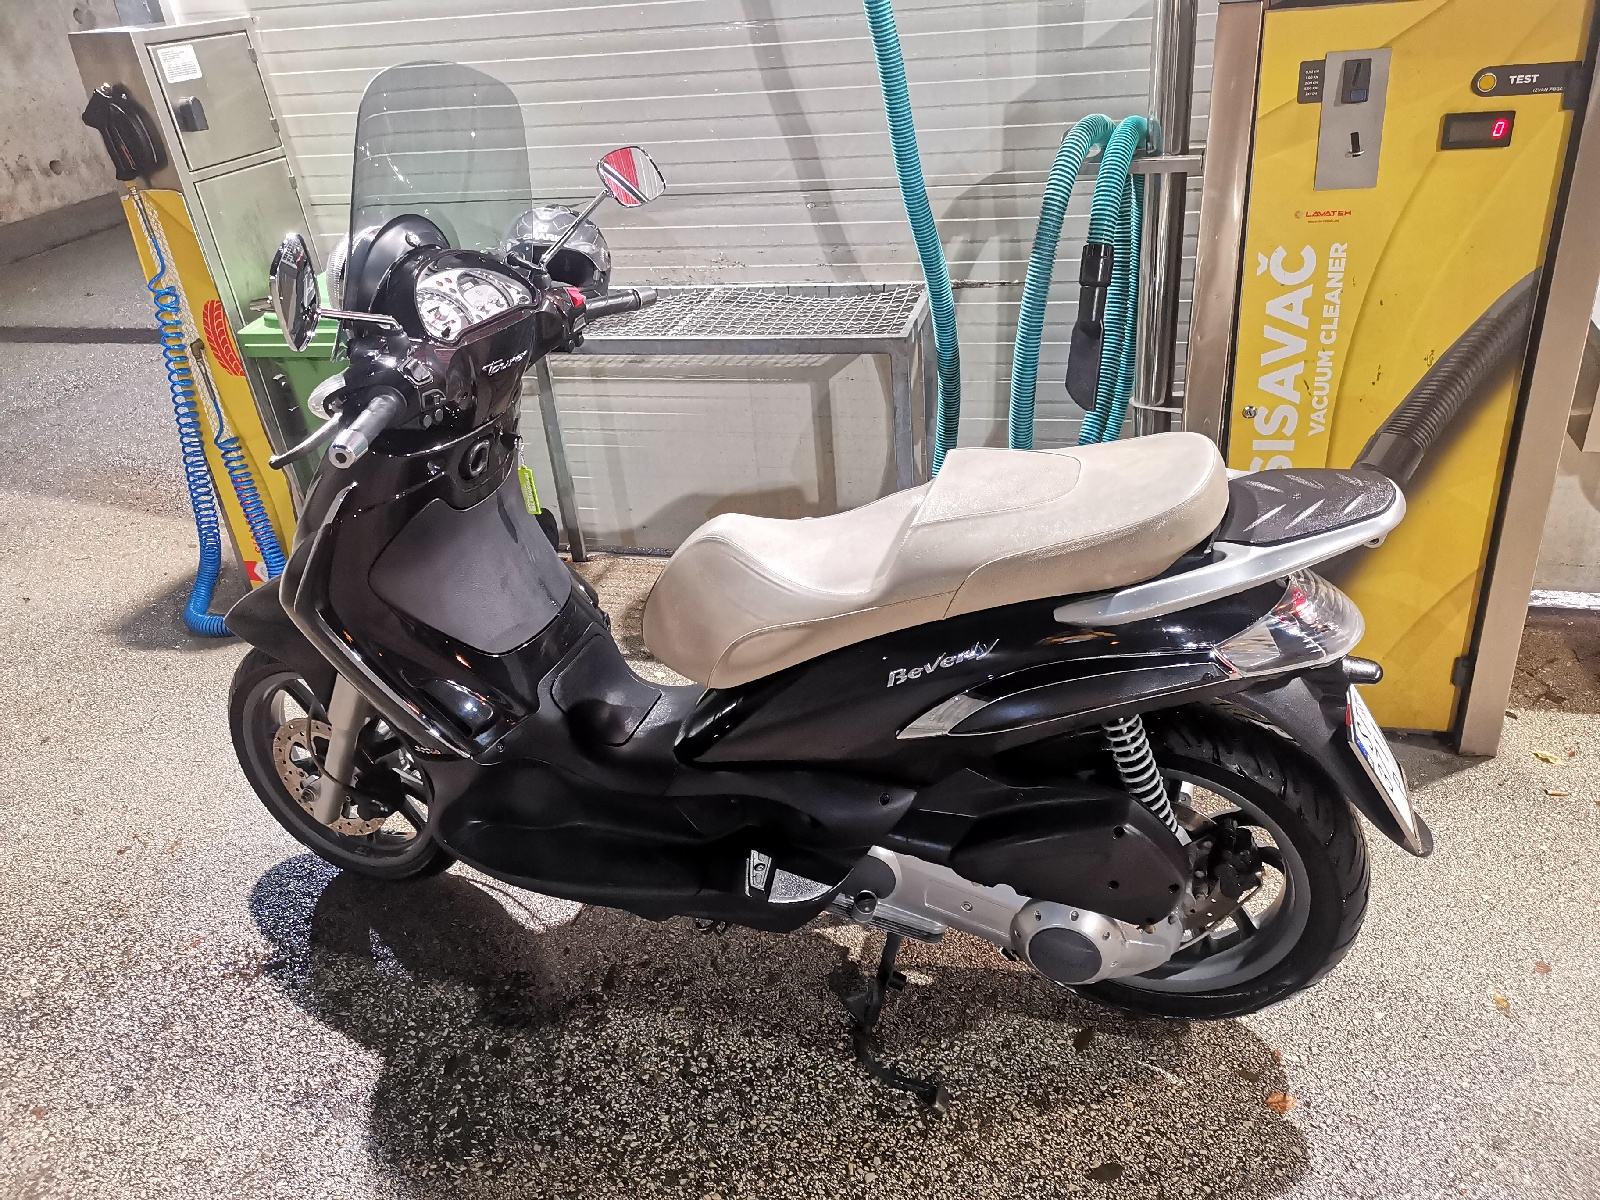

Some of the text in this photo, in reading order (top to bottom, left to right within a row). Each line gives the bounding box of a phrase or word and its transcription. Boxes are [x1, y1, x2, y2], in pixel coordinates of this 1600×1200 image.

[1509, 74, 1540, 85] TEST
[1492, 121, 1505, 137] 0
[1320, 242, 1348, 345] CLEANER
[1307, 350, 1335, 437] VACUUM
